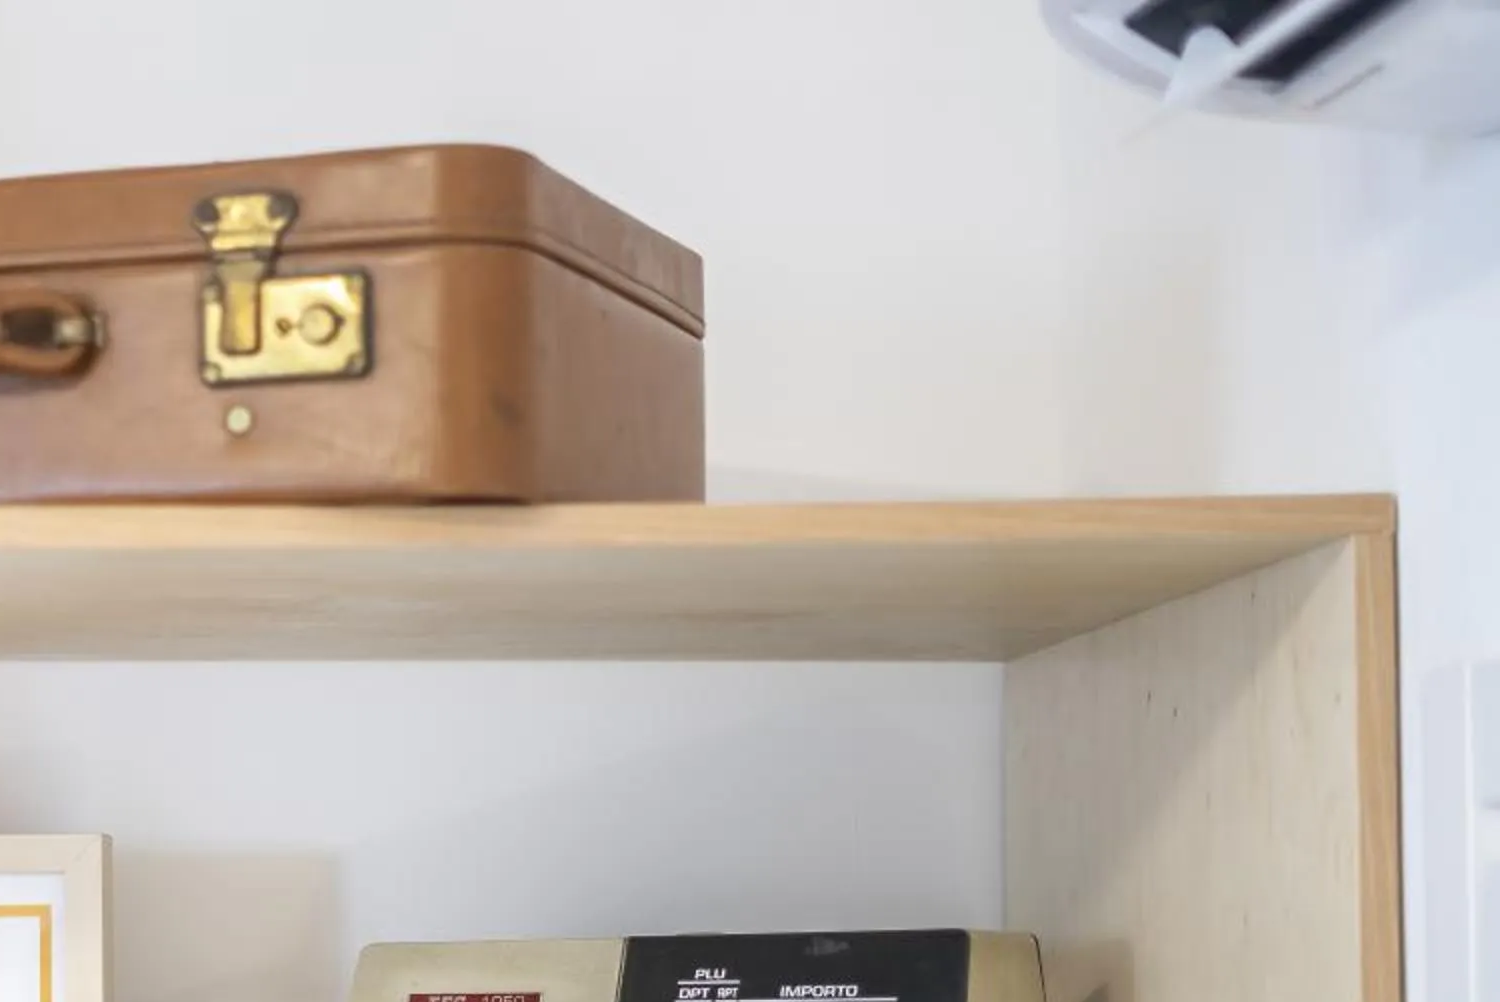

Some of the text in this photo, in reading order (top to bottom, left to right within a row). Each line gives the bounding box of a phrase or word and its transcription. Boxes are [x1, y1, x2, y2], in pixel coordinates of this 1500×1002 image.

[694, 968, 726, 980] PLU
[678, 986, 710, 999] DPT
[779, 985, 859, 998] IMPORTO
